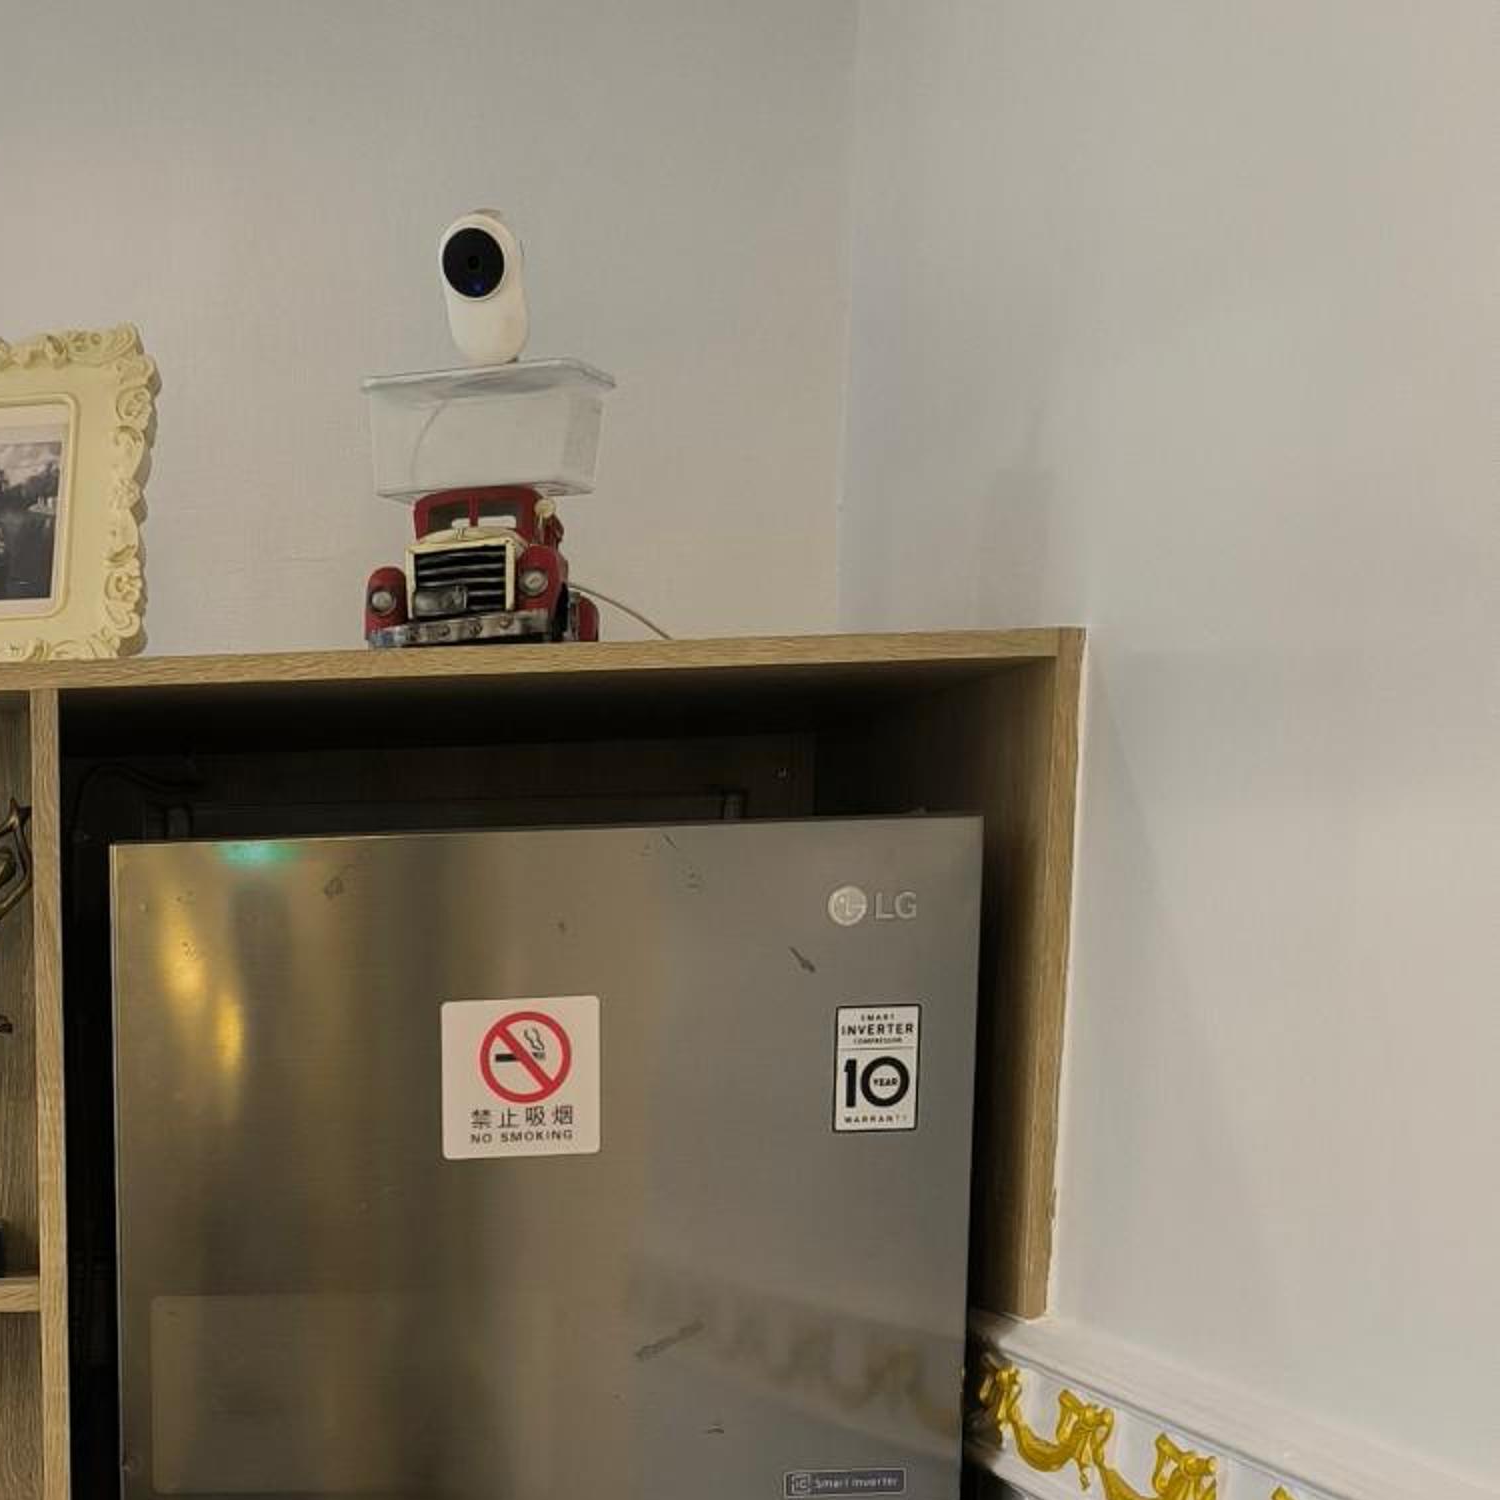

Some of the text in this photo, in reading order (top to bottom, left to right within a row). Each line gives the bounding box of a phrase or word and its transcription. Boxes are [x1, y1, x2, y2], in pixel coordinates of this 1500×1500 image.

[875, 891, 917, 920] LG
[860, 1013, 895, 1022] SMART
[841, 1023, 914, 1036] INVERTER
[844, 1056, 910, 1108] 10
[873, 1077, 899, 1087] YEAR
[471, 1105, 573, 1130] 禁止吸烟
[470, 1129, 573, 1144] NO SMOKING
